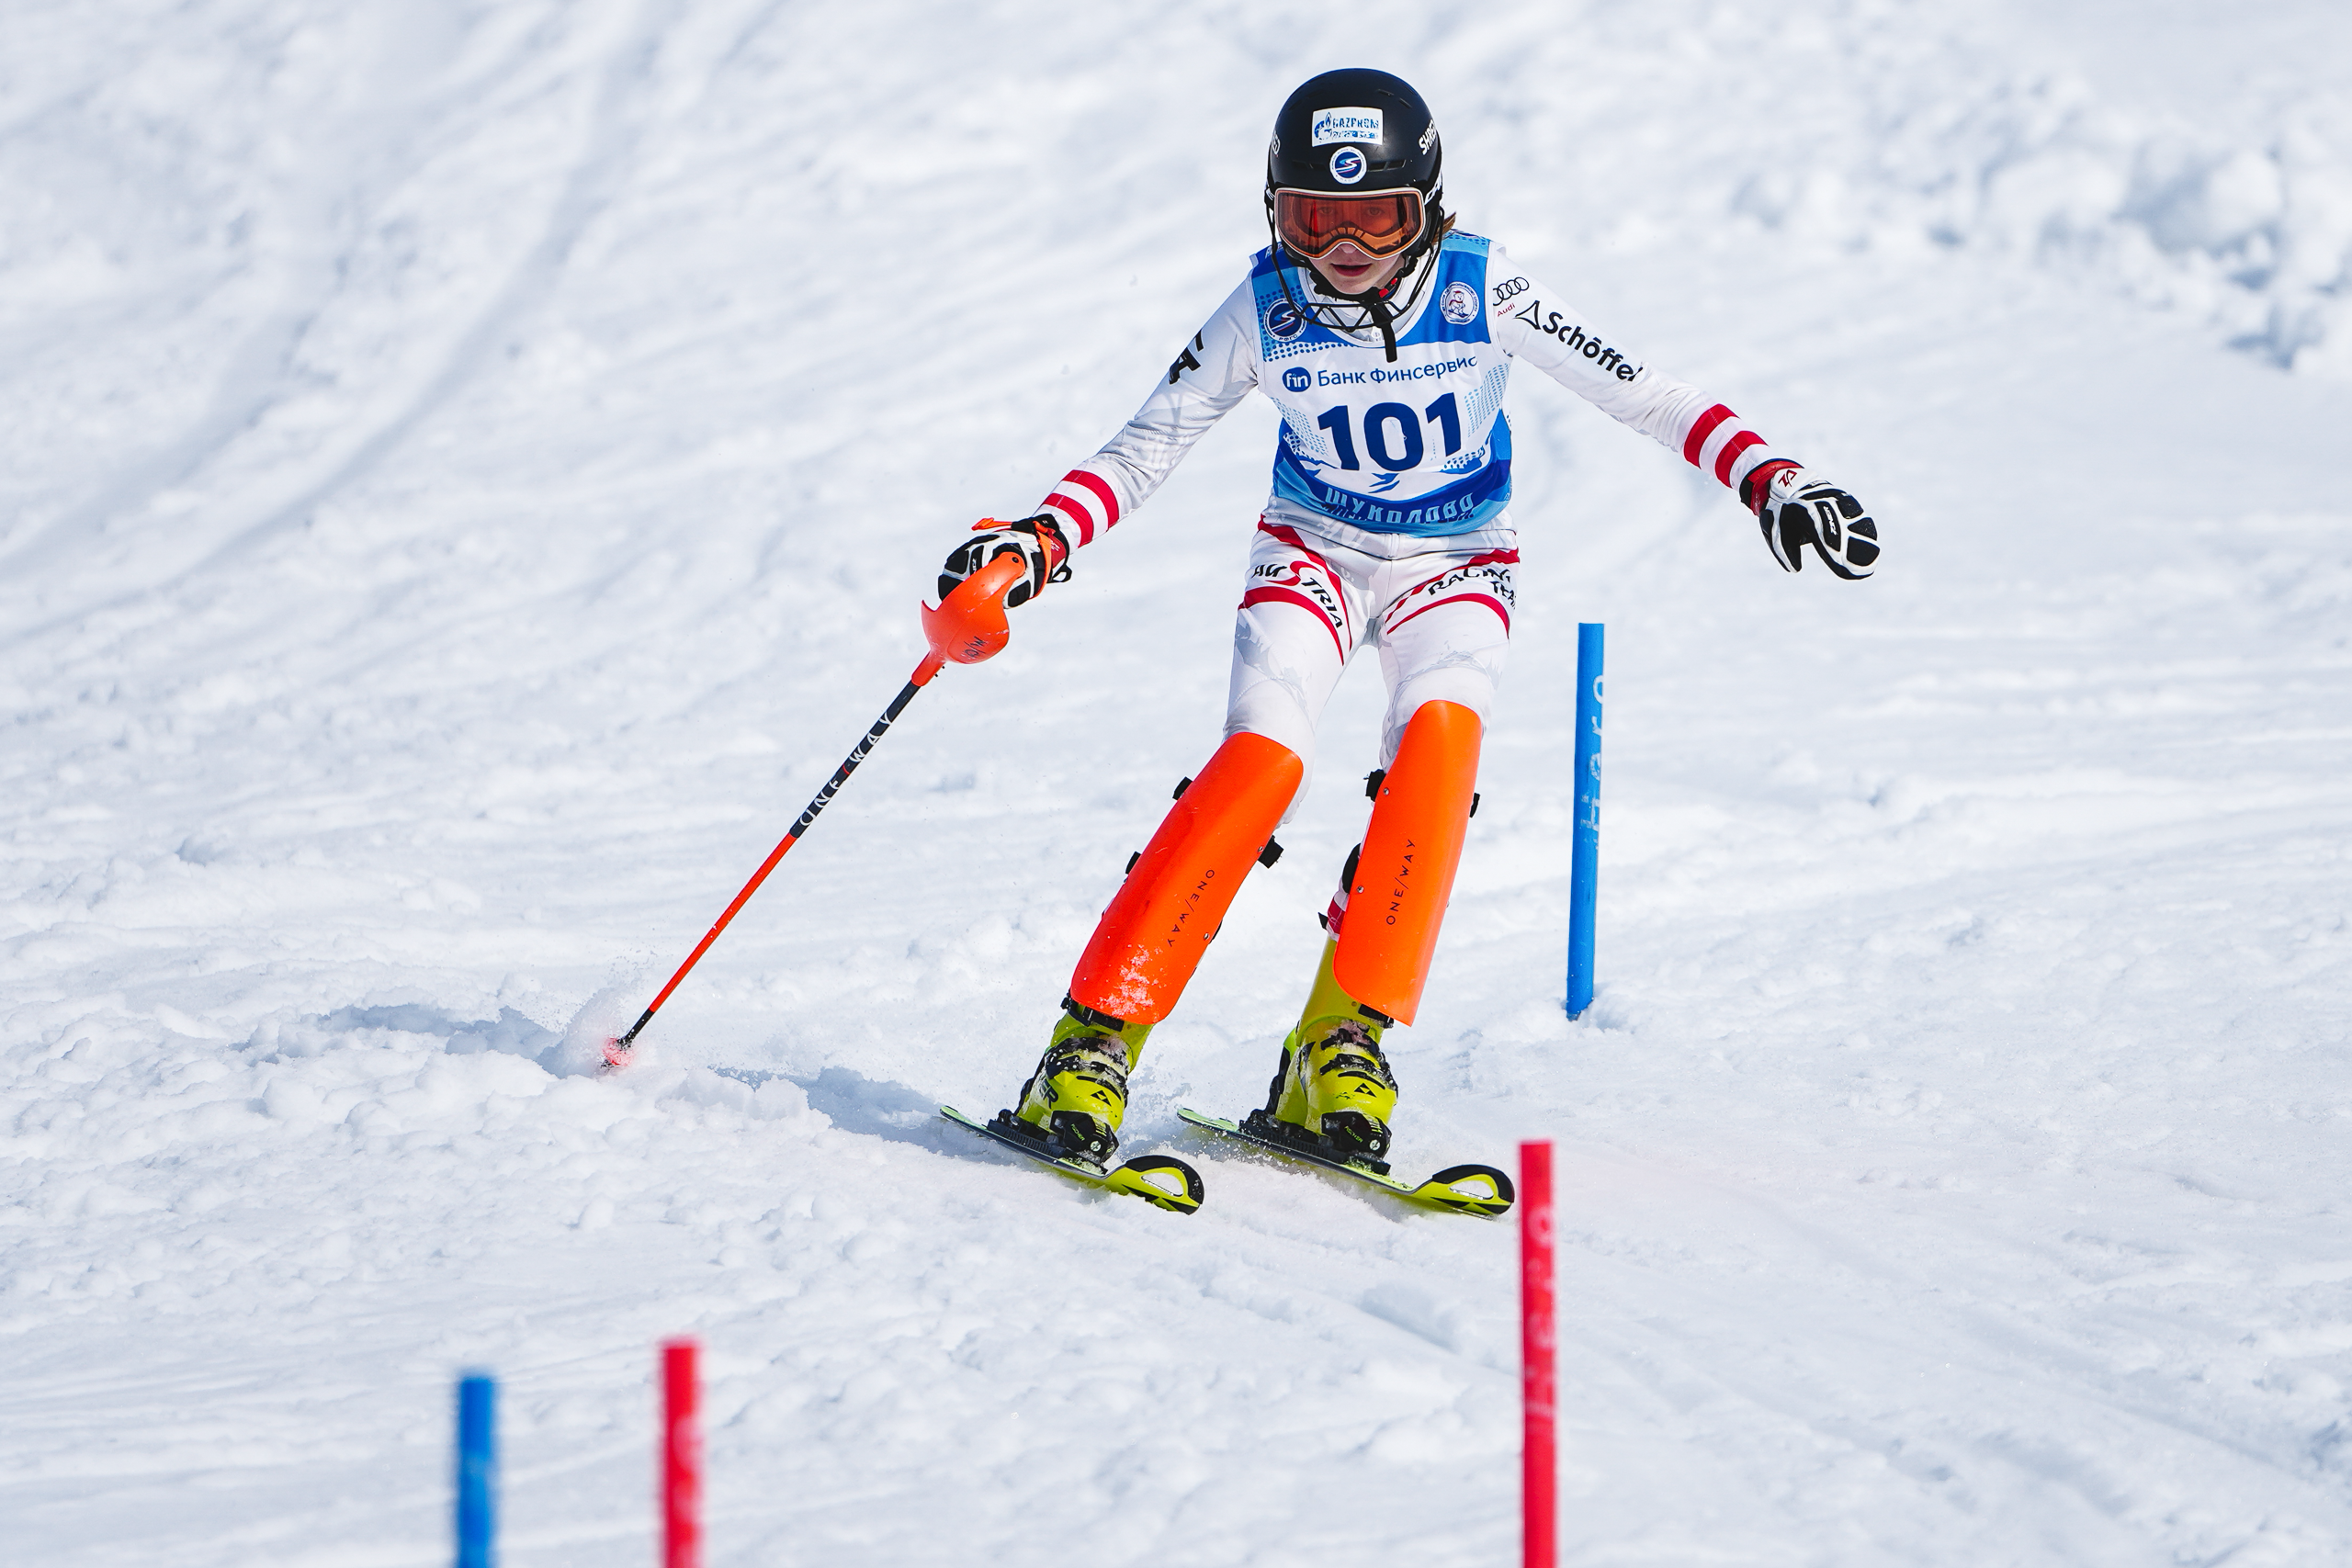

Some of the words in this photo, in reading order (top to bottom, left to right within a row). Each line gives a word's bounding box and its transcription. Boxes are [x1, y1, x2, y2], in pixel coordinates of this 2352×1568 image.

[1497, 302, 1516, 318] Audi
[1286, 373, 1308, 388] fin
[1317, 369, 1366, 387] Банк
[1370, 355, 1478, 384] Финсервис
[1542, 311, 1644, 382] Schöffel
[1317, 391, 1462, 472] 101
[1250, 560, 1343, 628] AUSTRIA
[1385, 839, 1416, 926] ONE/WAY
